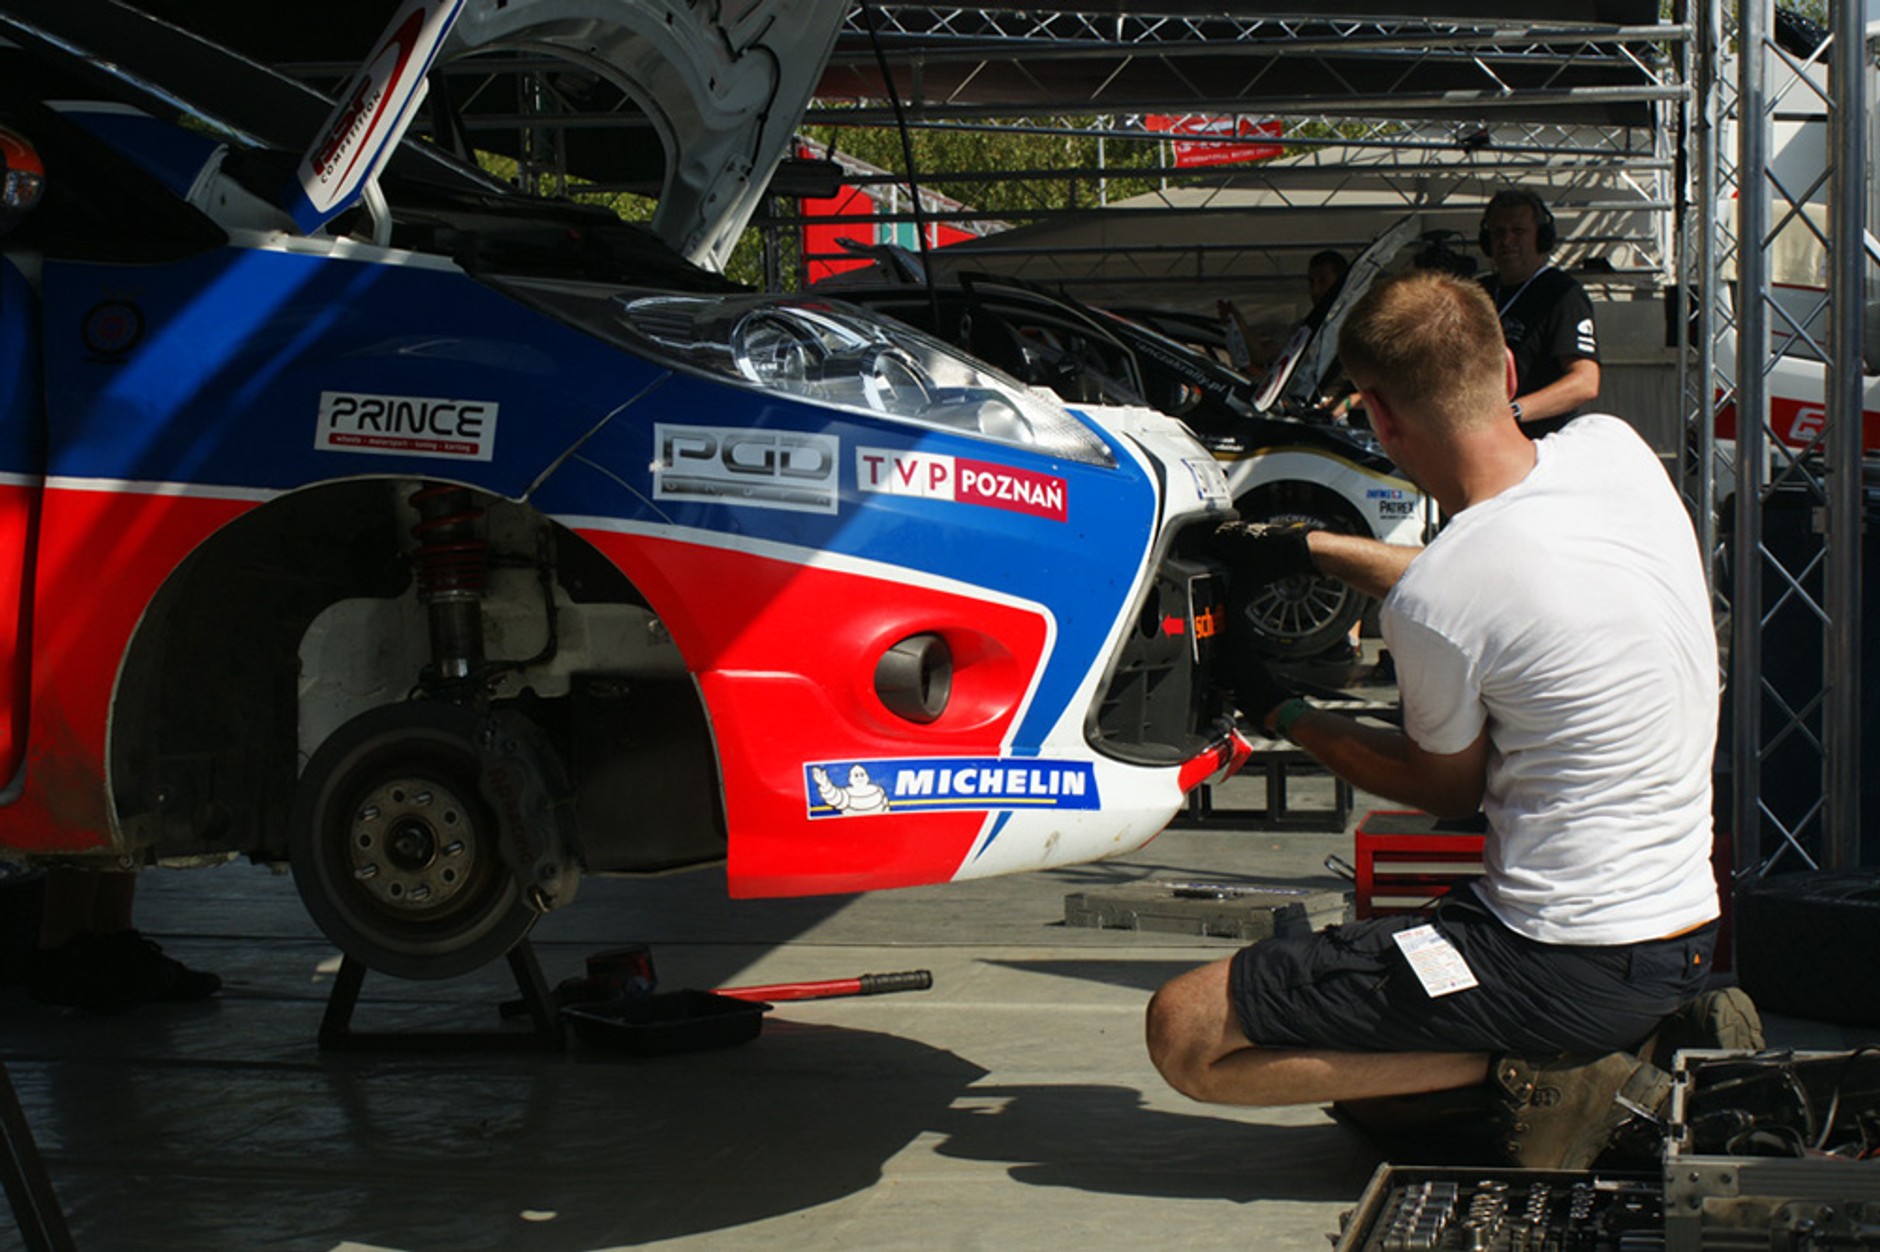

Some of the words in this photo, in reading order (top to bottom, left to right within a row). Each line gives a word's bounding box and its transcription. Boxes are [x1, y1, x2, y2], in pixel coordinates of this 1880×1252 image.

[320, 90, 381, 184] COMPETITION
[330, 397, 484, 438] PRINCE
[662, 433, 832, 480] PGD
[863, 455, 947, 490] TVP
[962, 469, 1062, 511] POZNAŃ
[1379, 500, 1415, 514] PATREX
[894, 768, 1086, 796] MICHELIN
